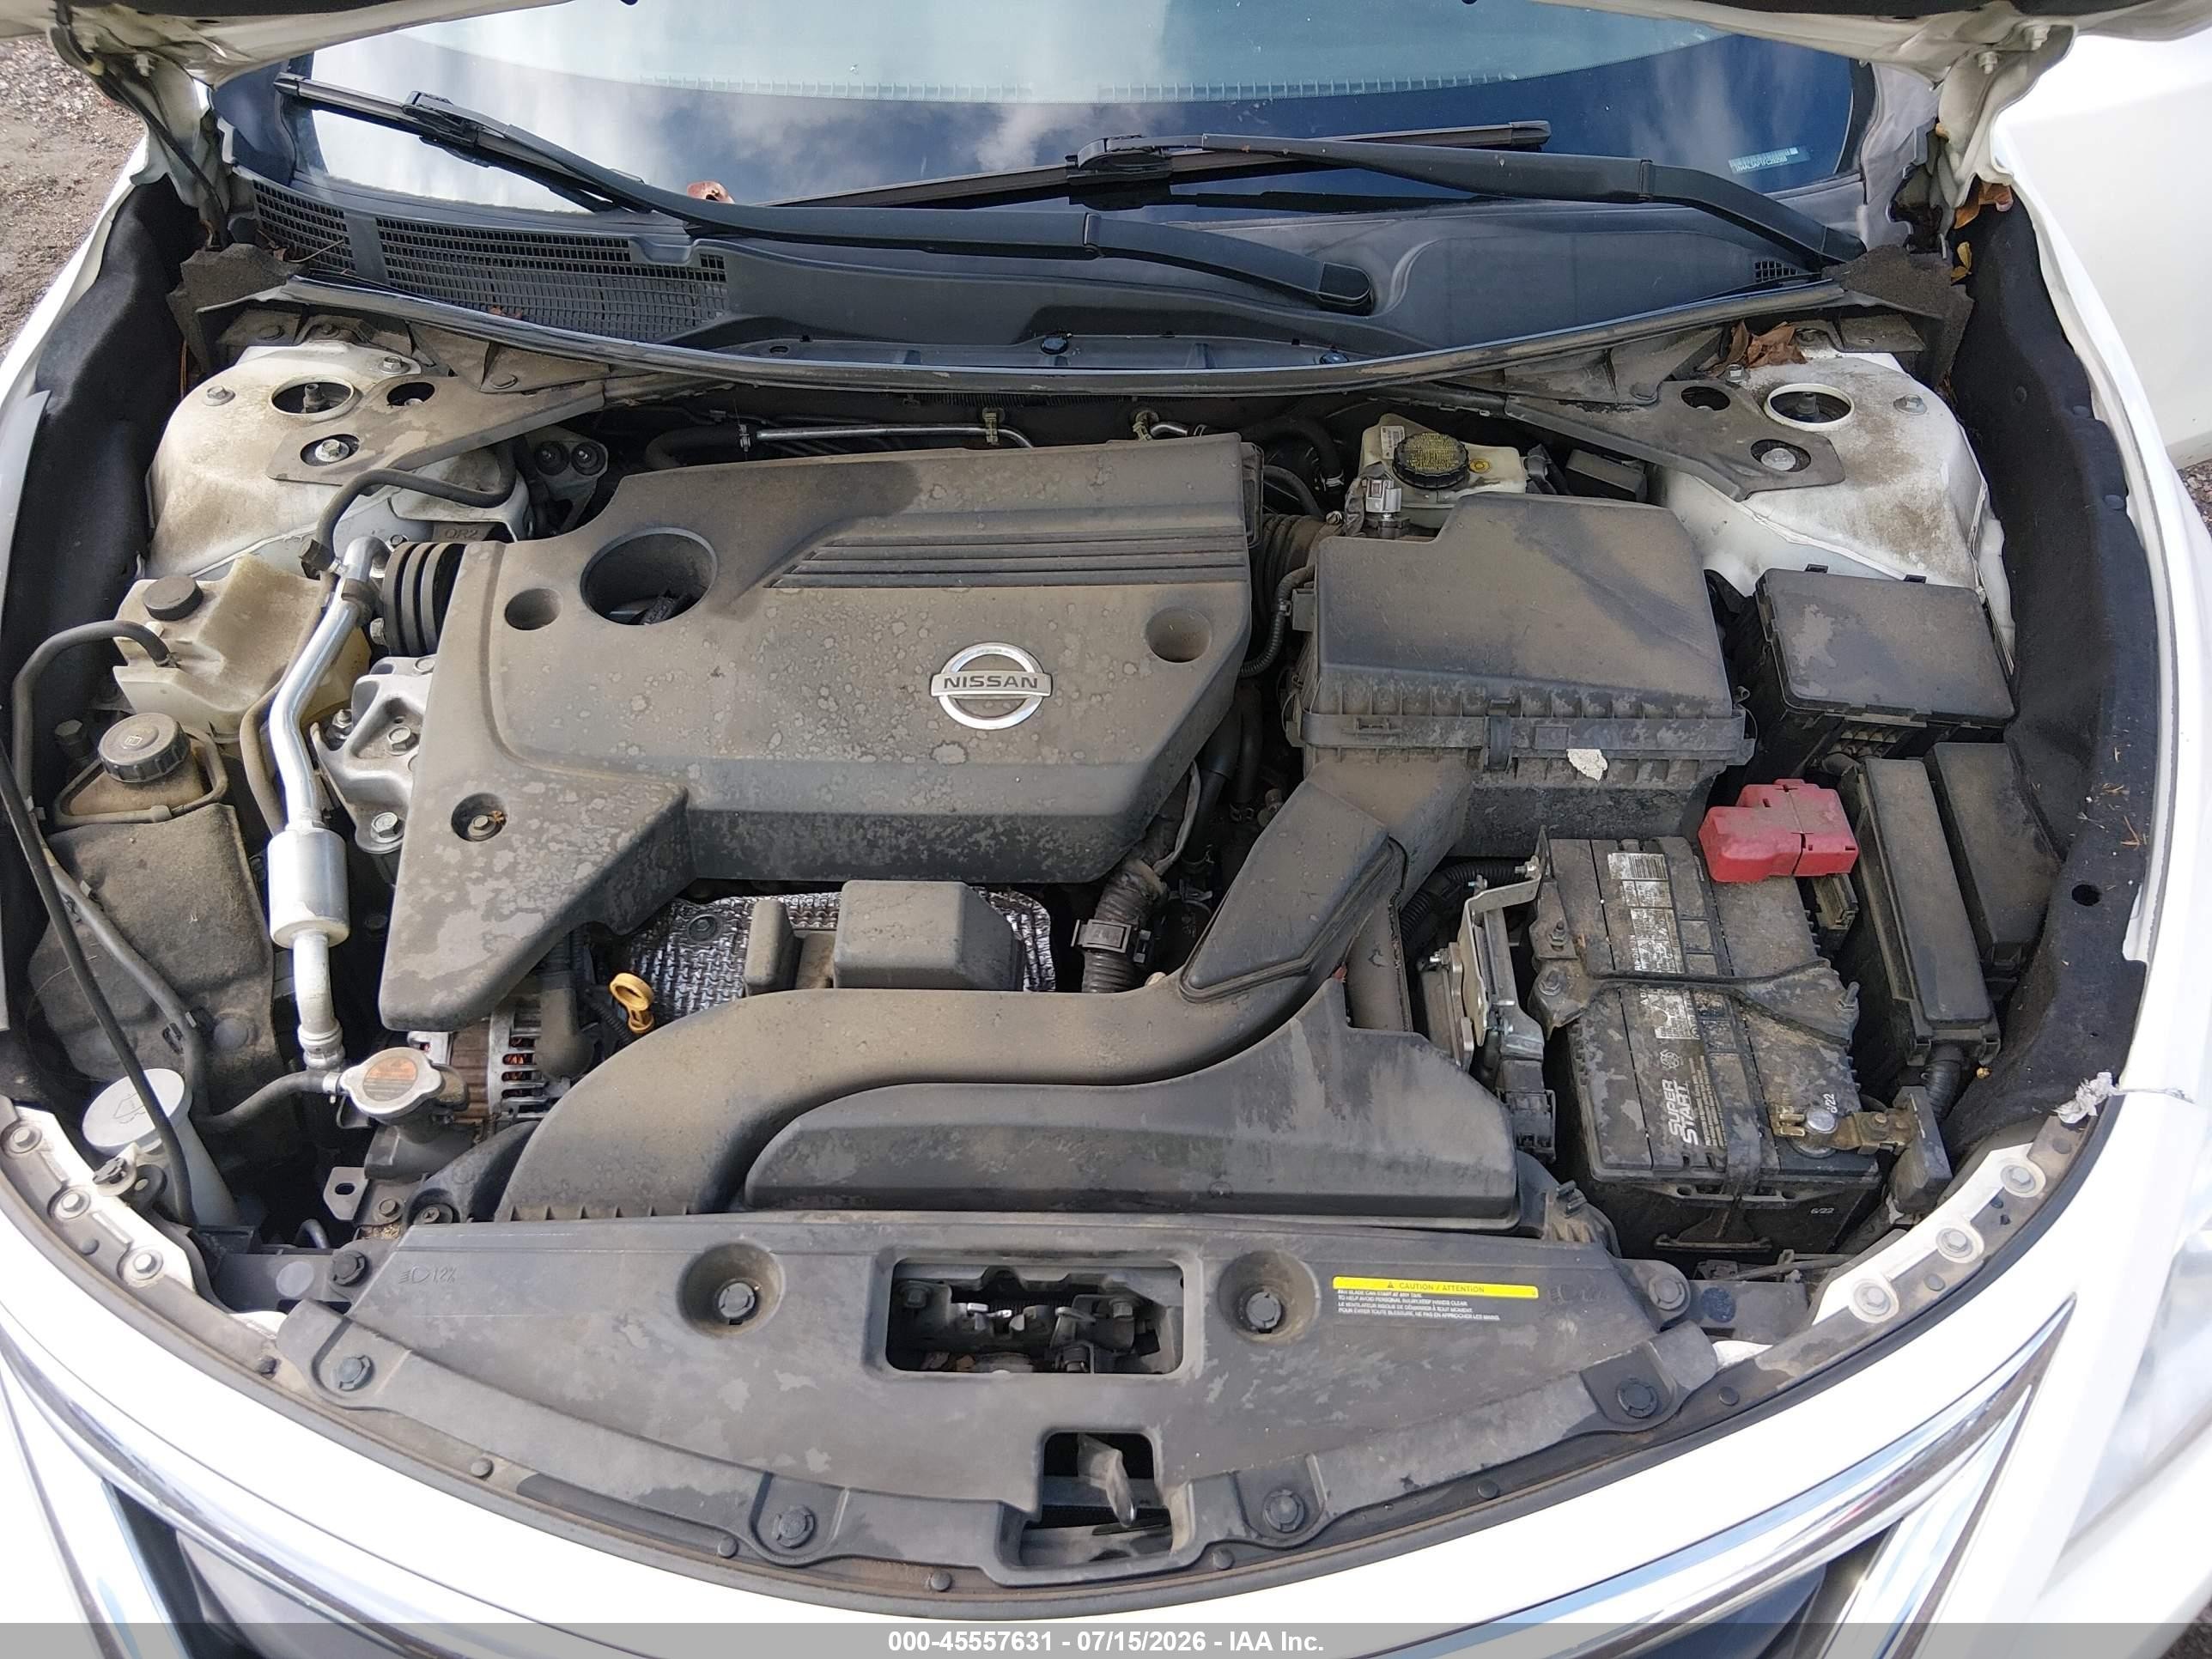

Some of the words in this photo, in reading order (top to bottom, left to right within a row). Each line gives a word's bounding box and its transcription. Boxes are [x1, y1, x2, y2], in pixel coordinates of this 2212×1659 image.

[944, 675, 1038, 690] NISSAN
[1662, 1079, 1684, 1136] SUPER
[1672, 1079, 1699, 1146] START
[1399, 1282, 1434, 1291] CAUTION
[1443, 1285, 1485, 1293] ATTENTION
